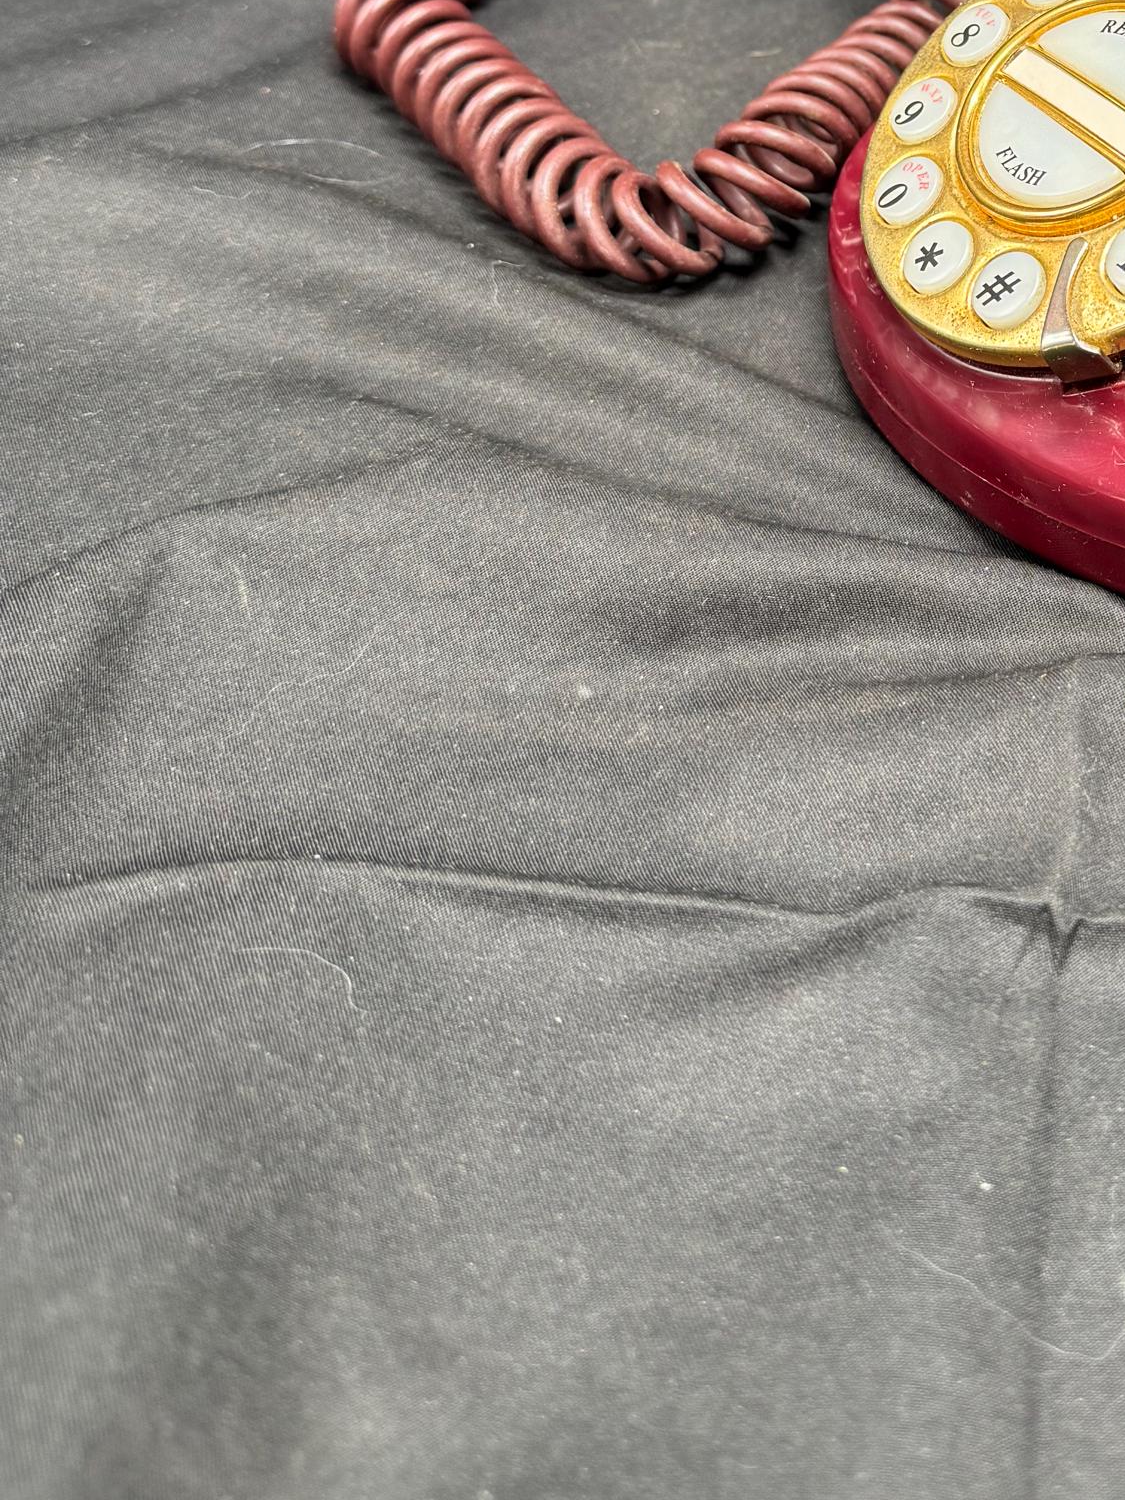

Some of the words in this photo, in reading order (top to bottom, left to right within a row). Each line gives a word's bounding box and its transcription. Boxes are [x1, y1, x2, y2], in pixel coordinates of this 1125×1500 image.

[951, 24, 980, 47] 8
[895, 101, 923, 124] 9
[902, 162, 930, 190] OPER
[996, 147, 1046, 185] FLASH
[878, 184, 907, 208] 0
[976, 272, 1021, 306] #
